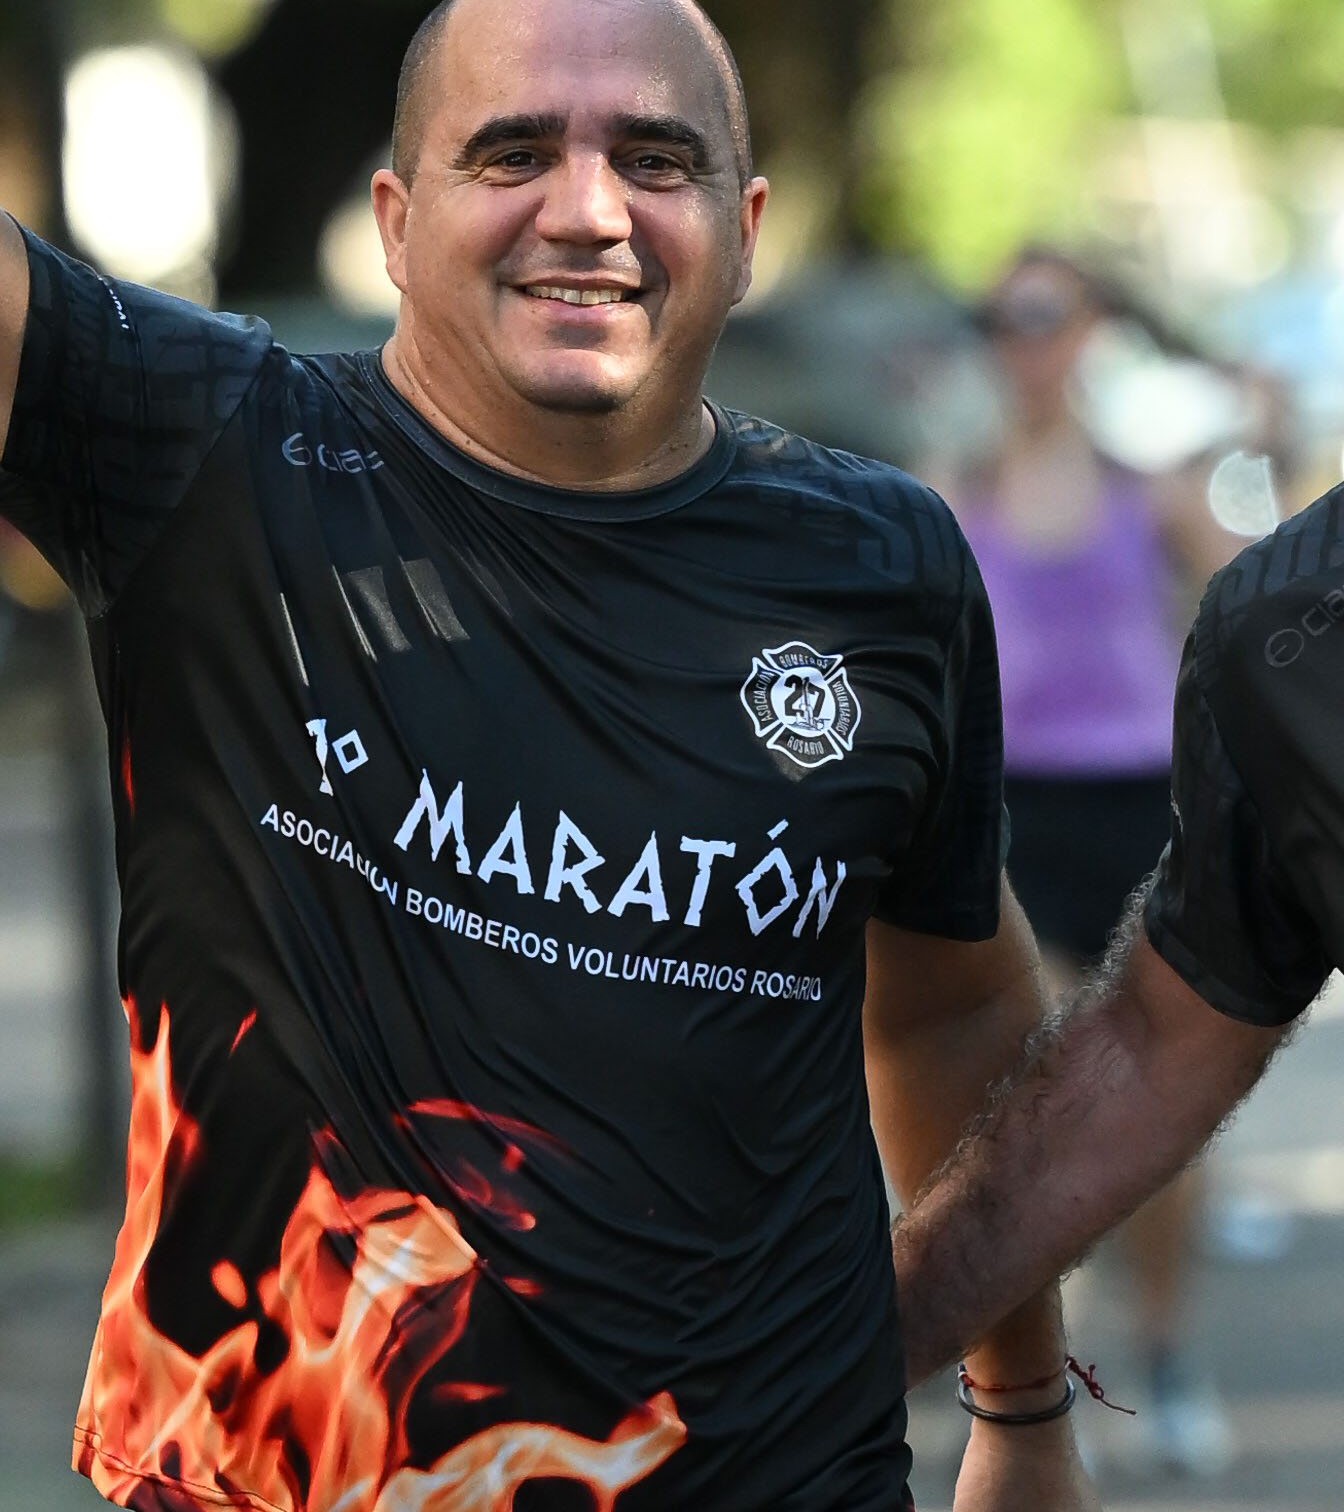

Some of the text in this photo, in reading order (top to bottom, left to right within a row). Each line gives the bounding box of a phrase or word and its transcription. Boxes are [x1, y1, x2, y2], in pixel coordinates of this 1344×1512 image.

[784, 674, 826, 721] 27
[394, 767, 847, 940] MARATÓN
[405, 887, 559, 965] BOMBEROS
[567, 942, 748, 994] VOLUNTARIOS
[750, 969, 822, 1002] ROSARIO
